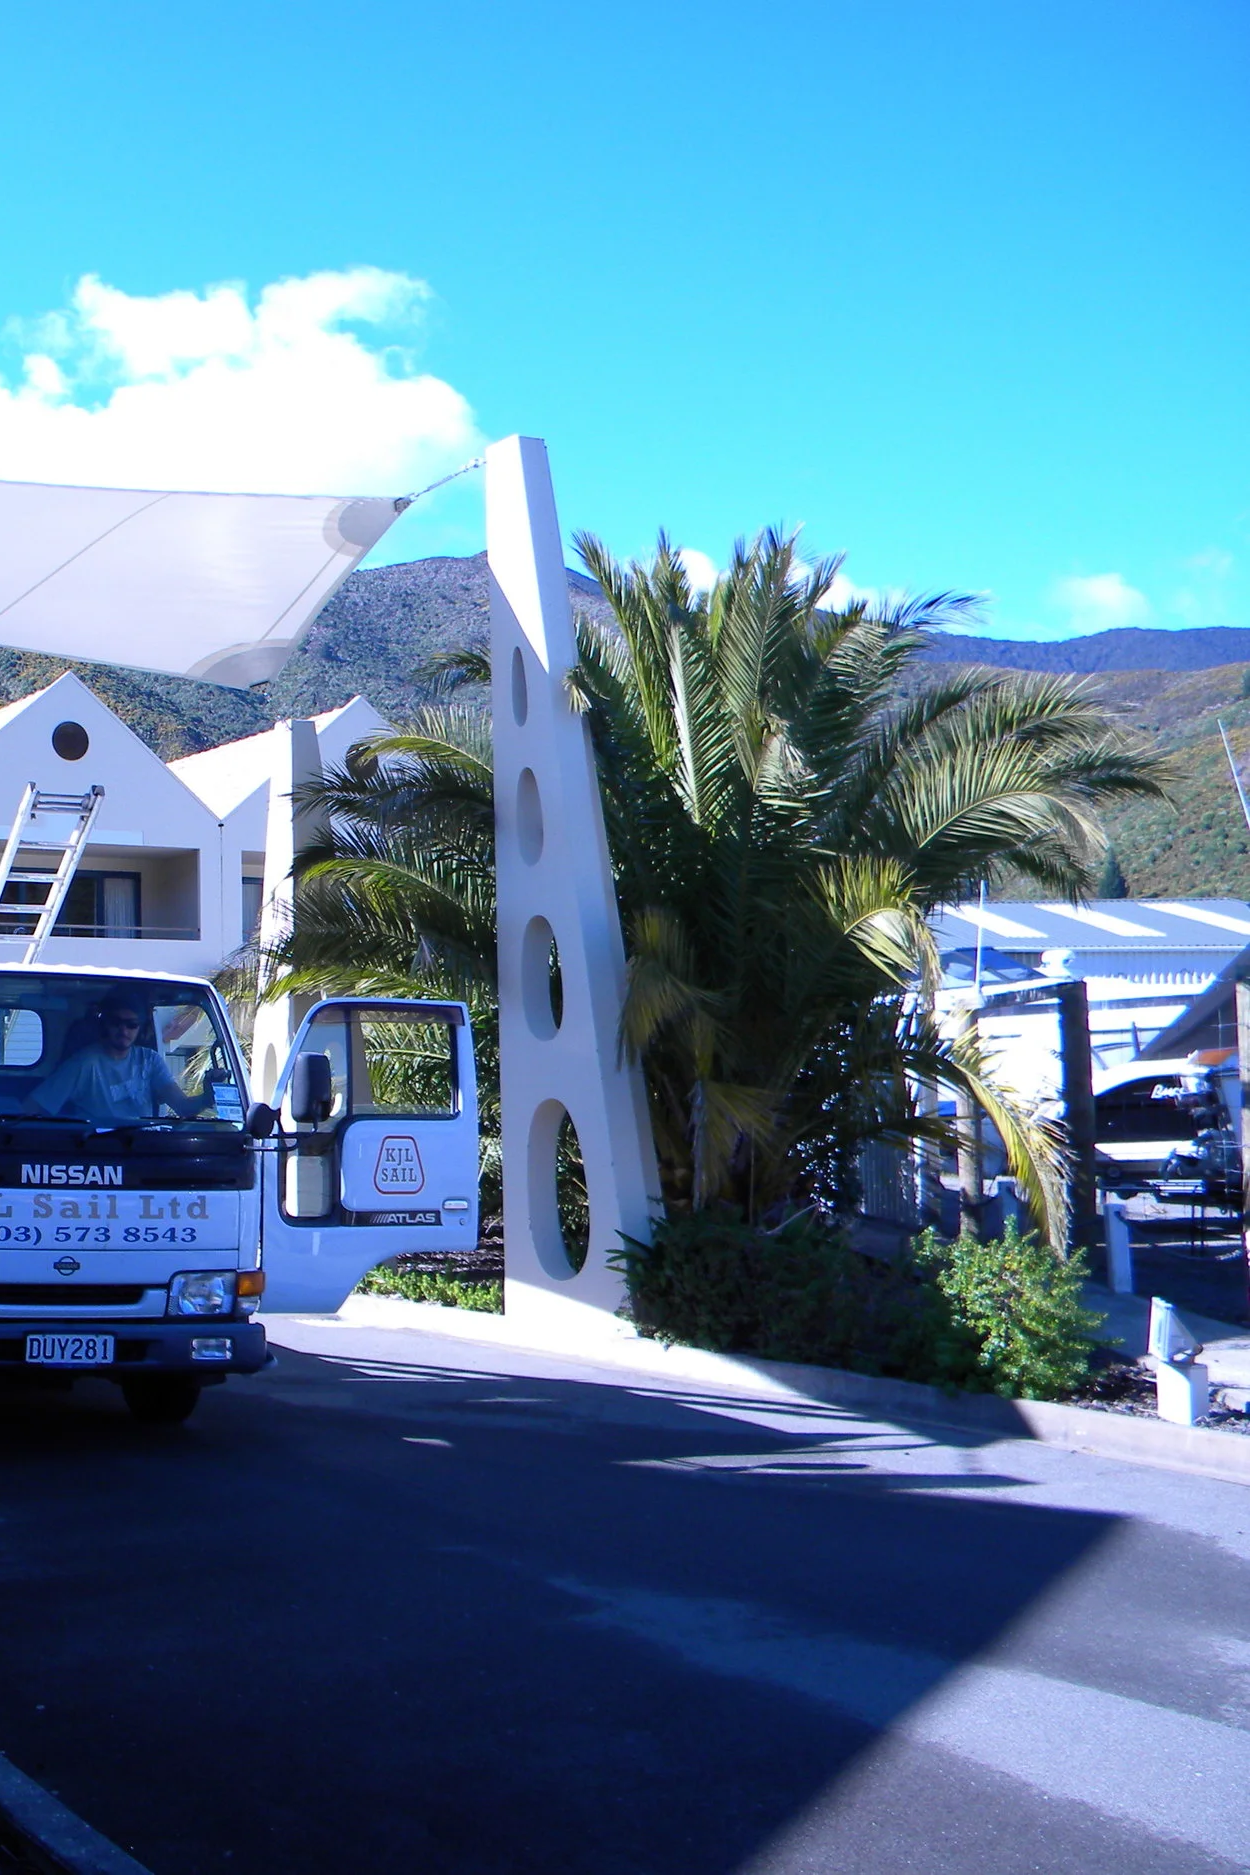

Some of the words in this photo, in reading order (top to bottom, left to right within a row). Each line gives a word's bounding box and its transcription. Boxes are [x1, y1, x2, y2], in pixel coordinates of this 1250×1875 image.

[385, 1148, 414, 1166] KJL
[21, 1164, 123, 1186] NISSAN
[381, 1167, 417, 1183] SAIL
[33, 1194, 119, 1220] Sail
[139, 1196, 210, 1220] Ltd
[387, 1213, 436, 1224] ATLAS
[53, 1226, 111, 1243] 573
[122, 1226, 198, 1244] 8543
[27, 1337, 111, 1362] DUY281
